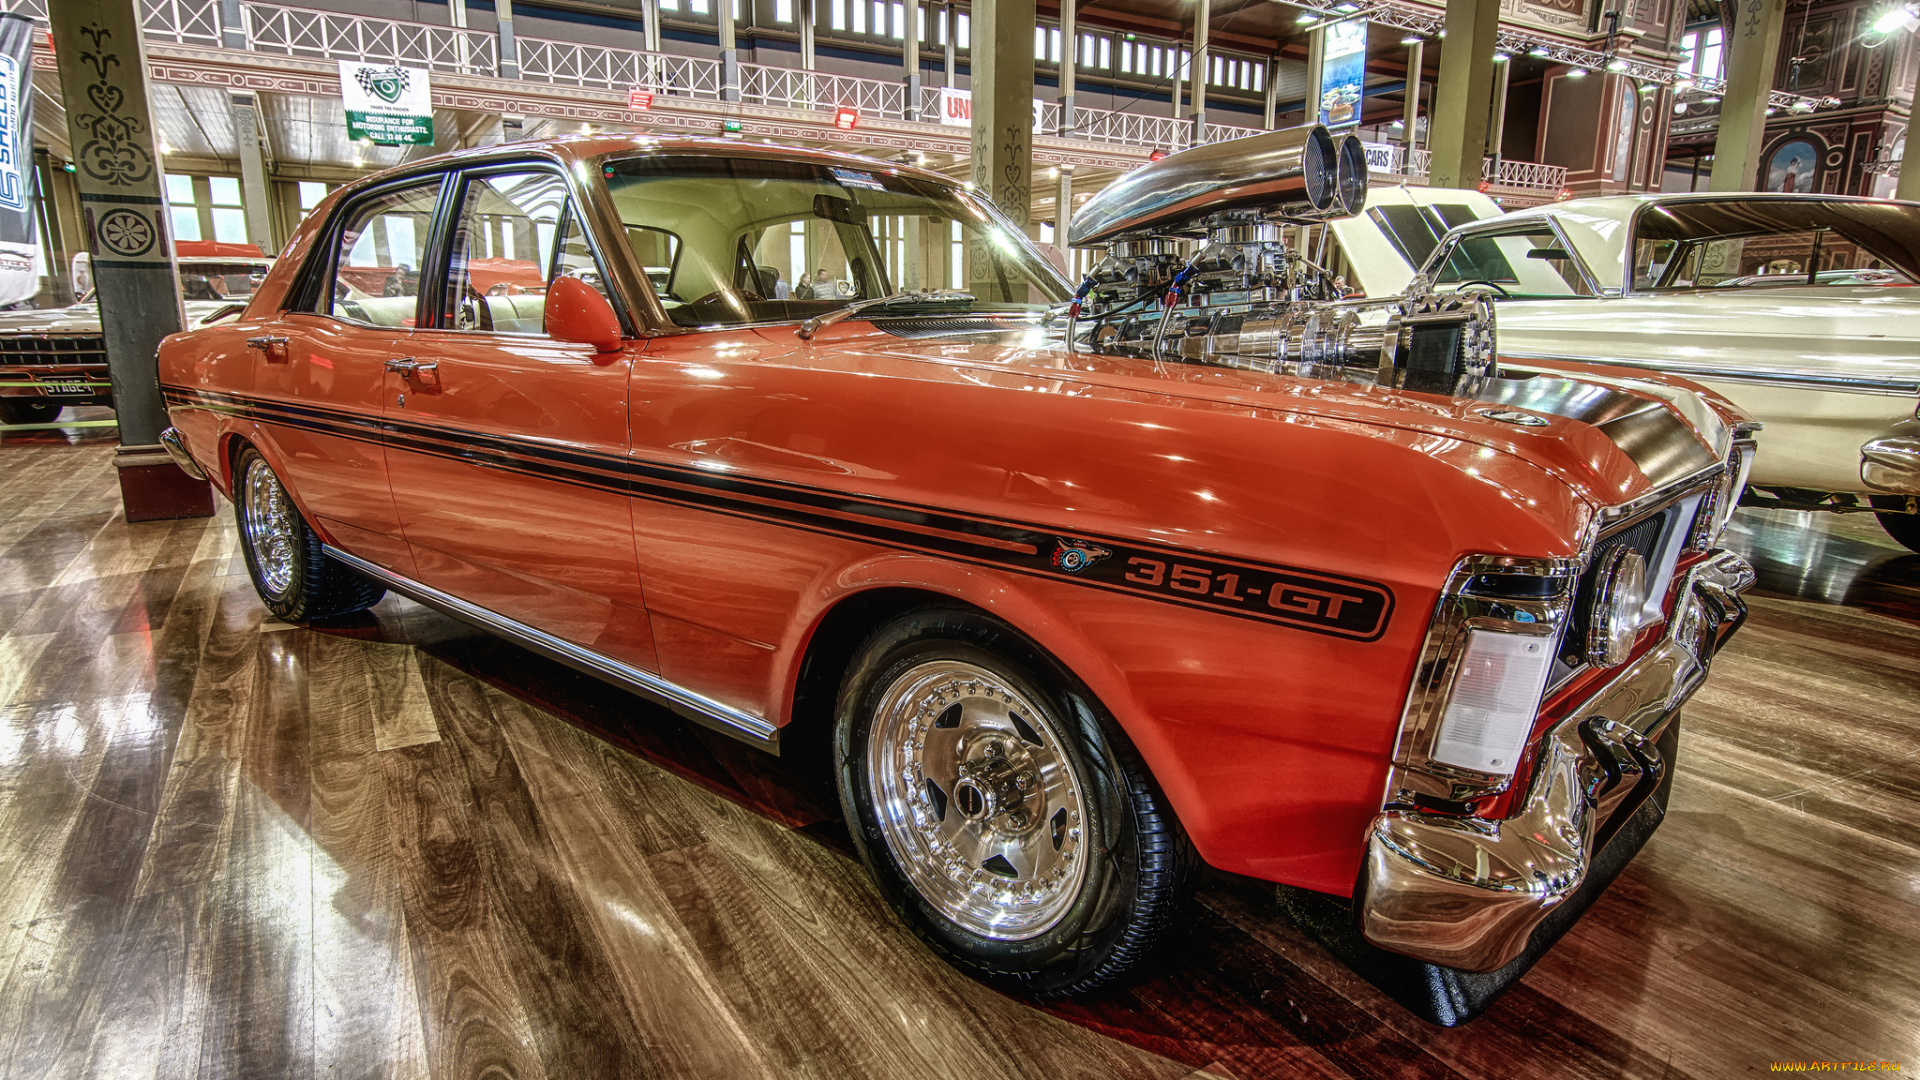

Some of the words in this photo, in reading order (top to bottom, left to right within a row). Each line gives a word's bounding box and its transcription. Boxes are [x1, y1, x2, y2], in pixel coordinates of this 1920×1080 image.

[365, 115, 400, 125] INSURANCE
[401, 118, 414, 126] FOR
[352, 121, 386, 132] MOTORING
[369, 131, 386, 140] CALL
[387, 133, 394, 141] 13
[1366, 148, 1389, 167] CARS
[1125, 556, 1363, 620] 351-GT
